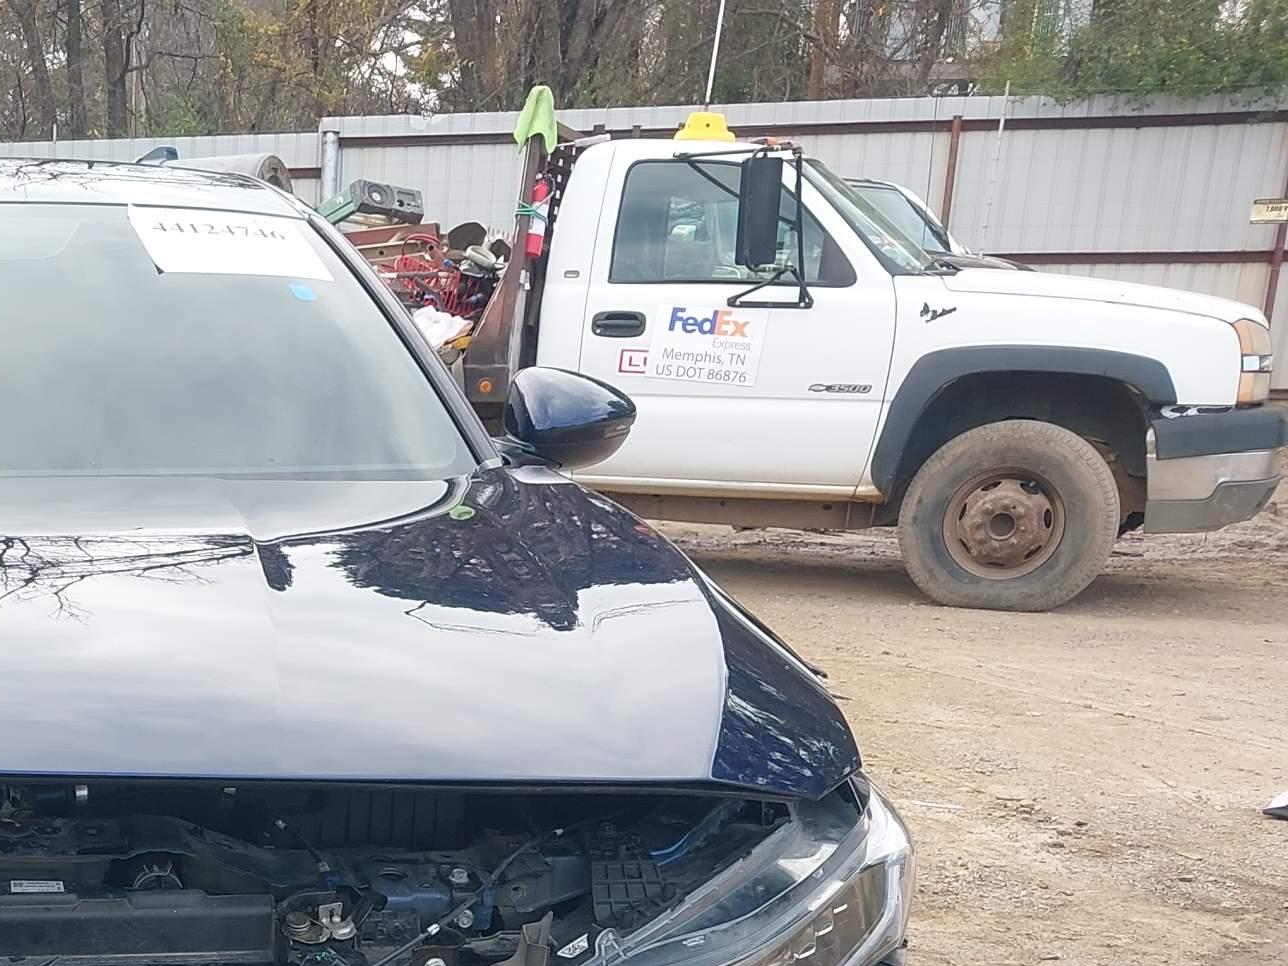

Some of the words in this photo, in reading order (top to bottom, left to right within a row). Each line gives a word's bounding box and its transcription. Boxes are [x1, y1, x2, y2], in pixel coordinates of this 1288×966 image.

[668, 306, 751, 338] FedEx
[712, 337, 752, 351] Express
[662, 347, 724, 366] Memphis,
[729, 353, 746, 366] TN
[655, 363, 672, 377] US
[676, 365, 703, 379] DOT
[706, 367, 747, 384] 86876
[830, 384, 873, 394] 3500
